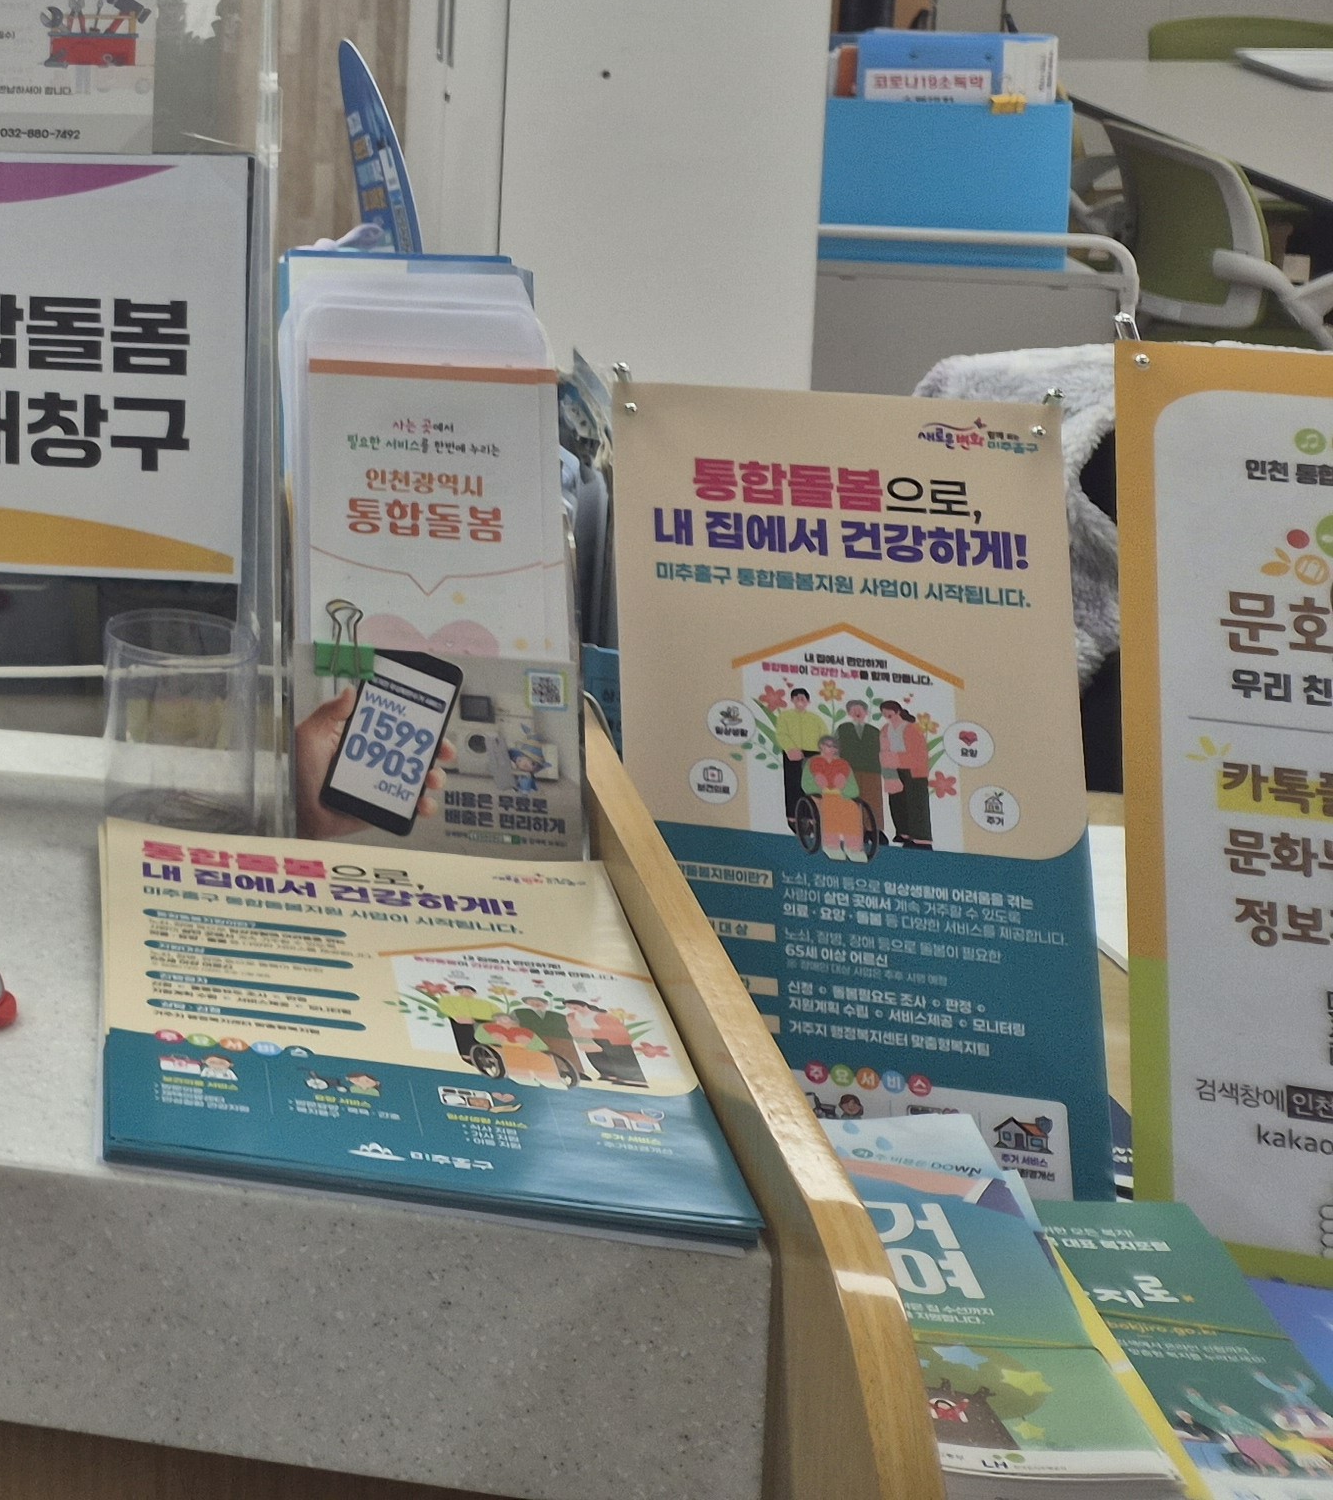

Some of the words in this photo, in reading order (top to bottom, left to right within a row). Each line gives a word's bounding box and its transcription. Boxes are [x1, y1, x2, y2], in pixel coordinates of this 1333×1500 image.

[393, 418, 416, 433] 사는
[422, 418, 454, 434] 곳에서
[347, 434, 380, 450] 필요한
[386, 438, 429, 453] 서비스를
[988, 441, 1039, 454] 미추홀구
[366, 468, 483, 497] 인천광역시
[1246, 460, 1289, 482] 인천
[693, 456, 982, 525] 통합돌봄으로,
[347, 497, 504, 543] 통합돌봄
[654, 507, 693, 546] 내
[705, 510, 828, 557] 집에서
[841, 520, 1029, 571] 건강하게!
[657, 562, 731, 586] 미추홀구
[738, 567, 854, 596] 통합돌봄지원
[860, 577, 919, 600] 사업이
[926, 582, 1031, 608] 시작됩니다.
[1232, 670, 1292, 702] 우리
[365, 690, 406, 717] www.
[359, 706, 434, 751] 1599
[345, 733, 425, 786] 0903
[374, 776, 415, 802] .or.kr
[499, 813, 566, 835] 편리하게
[986, 816, 1004, 826] 주거
[1223, 828, 1333, 879] 문화
[142, 862, 181, 882] 내
[194, 867, 317, 898] 집에서
[330, 884, 519, 916] 건강하게!
[852, 894, 891, 911] 곳에서
[351, 907, 409, 924] 사업이
[416, 915, 524, 935] 시작됩니다.
[1234, 897, 1333, 947] 정보
[785, 945, 818, 959] 65세
[821, 949, 846, 963] 이상
[850, 951, 888, 967] 어르신
[789, 1021, 827, 1037] 거주지
[889, 1009, 953, 1028] 서비스제공
[1195, 1078, 1285, 1113] 검색창에
[410, 1151, 494, 1170] 미추홀구
[1002, 1153, 1019, 1164] 주거
[1022, 1155, 1048, 1168] 서비스
[1084, 1275, 1179, 1308] 지로
[981, 1457, 1009, 1471] LH
